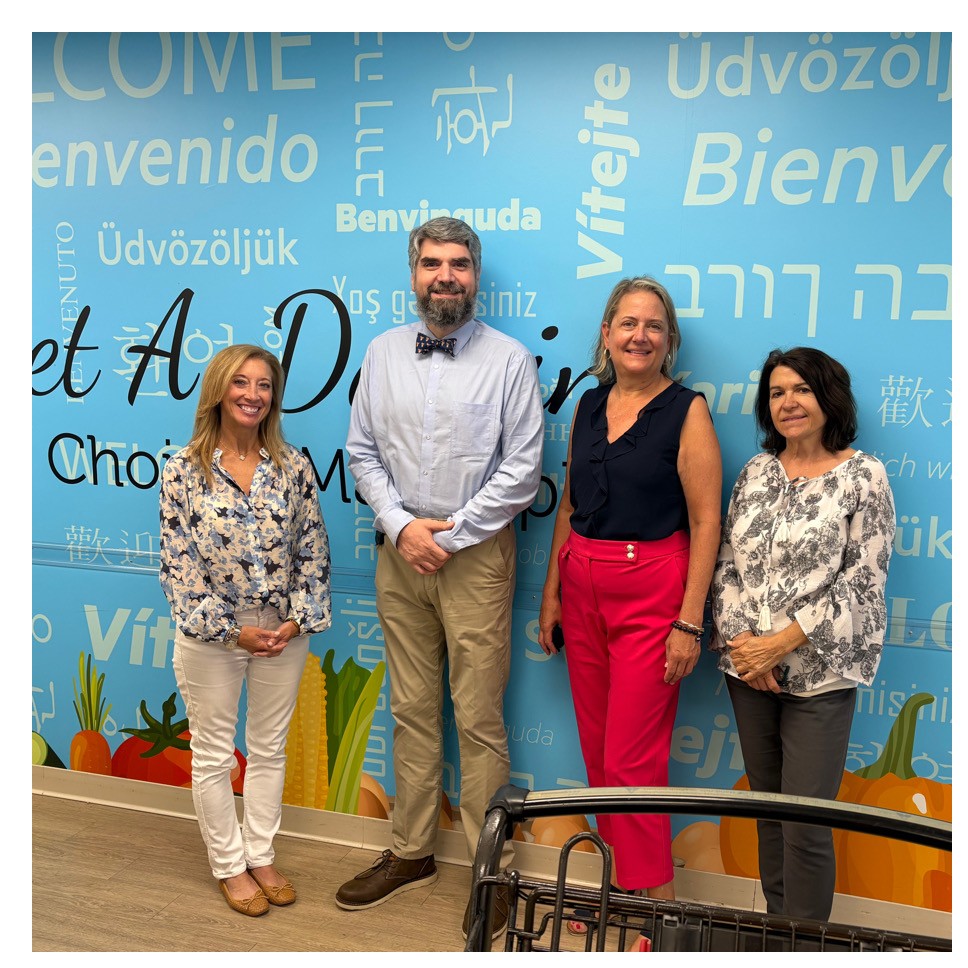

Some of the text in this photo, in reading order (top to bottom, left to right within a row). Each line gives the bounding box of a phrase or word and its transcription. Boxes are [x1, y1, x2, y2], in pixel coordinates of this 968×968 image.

[576, 62, 641, 280] Vítejte
[683, 127, 952, 206] Bienv
[336, 198, 542, 232] Benviuda
[98, 222, 299, 275] Üdvözöljük
